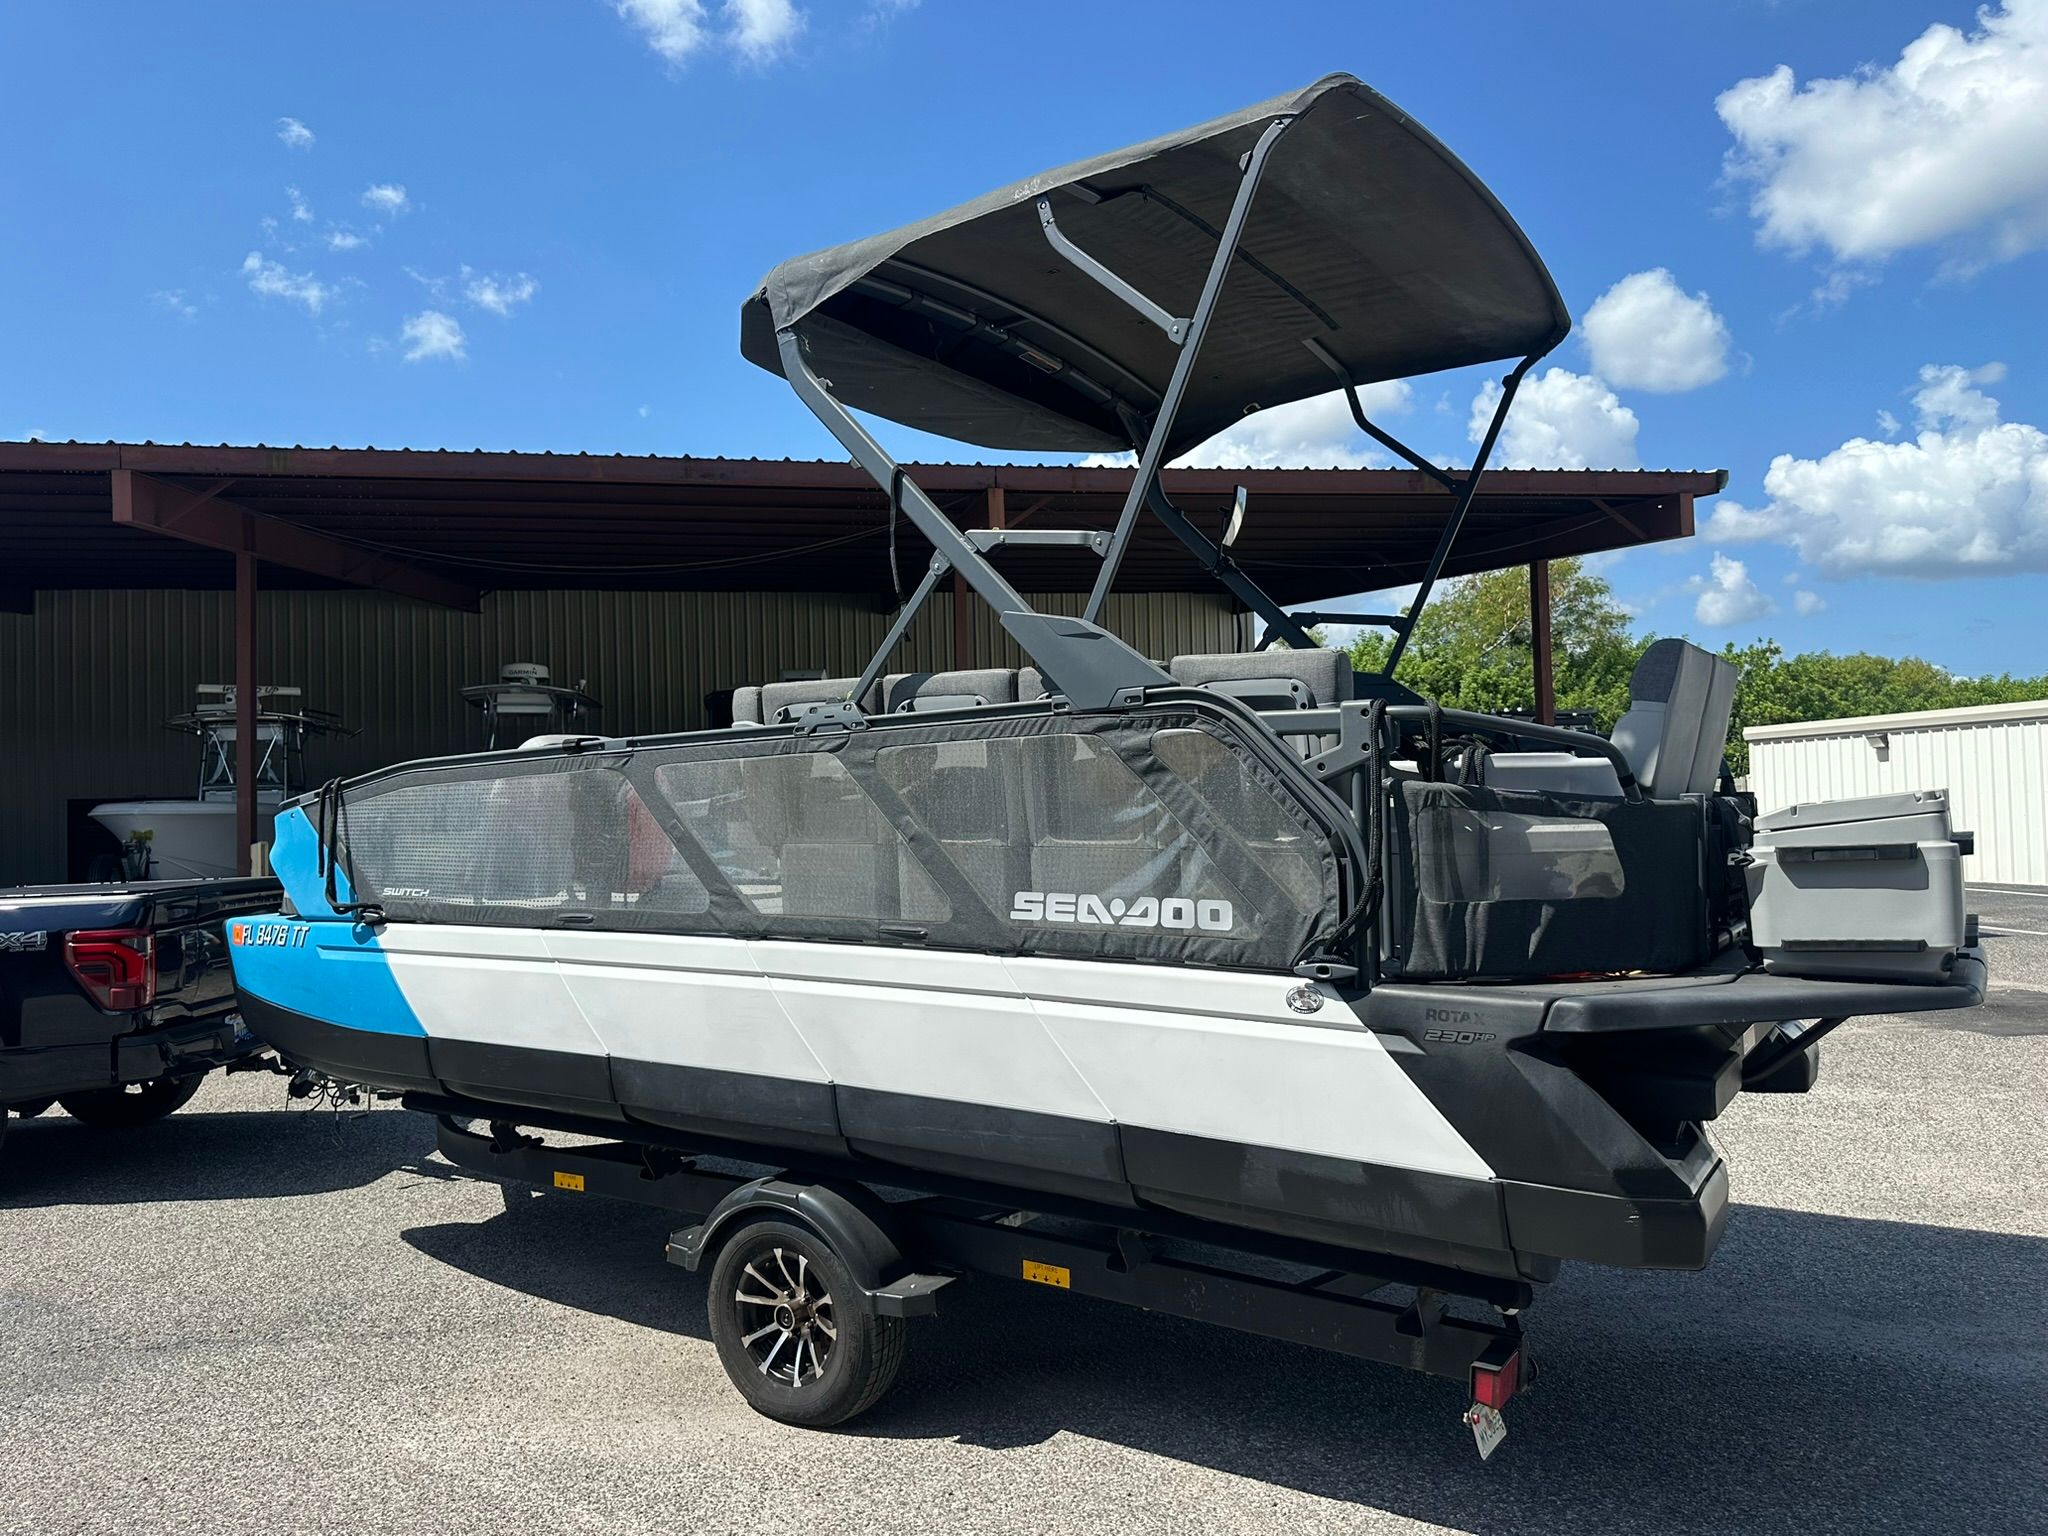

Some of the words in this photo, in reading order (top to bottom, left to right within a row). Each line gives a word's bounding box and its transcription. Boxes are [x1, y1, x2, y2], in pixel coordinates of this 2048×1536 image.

[382, 887, 430, 897] SWITCH
[242, 924, 255, 946] FL
[292, 925, 312, 949] TT
[1425, 1008, 1486, 1026] ROTAX
